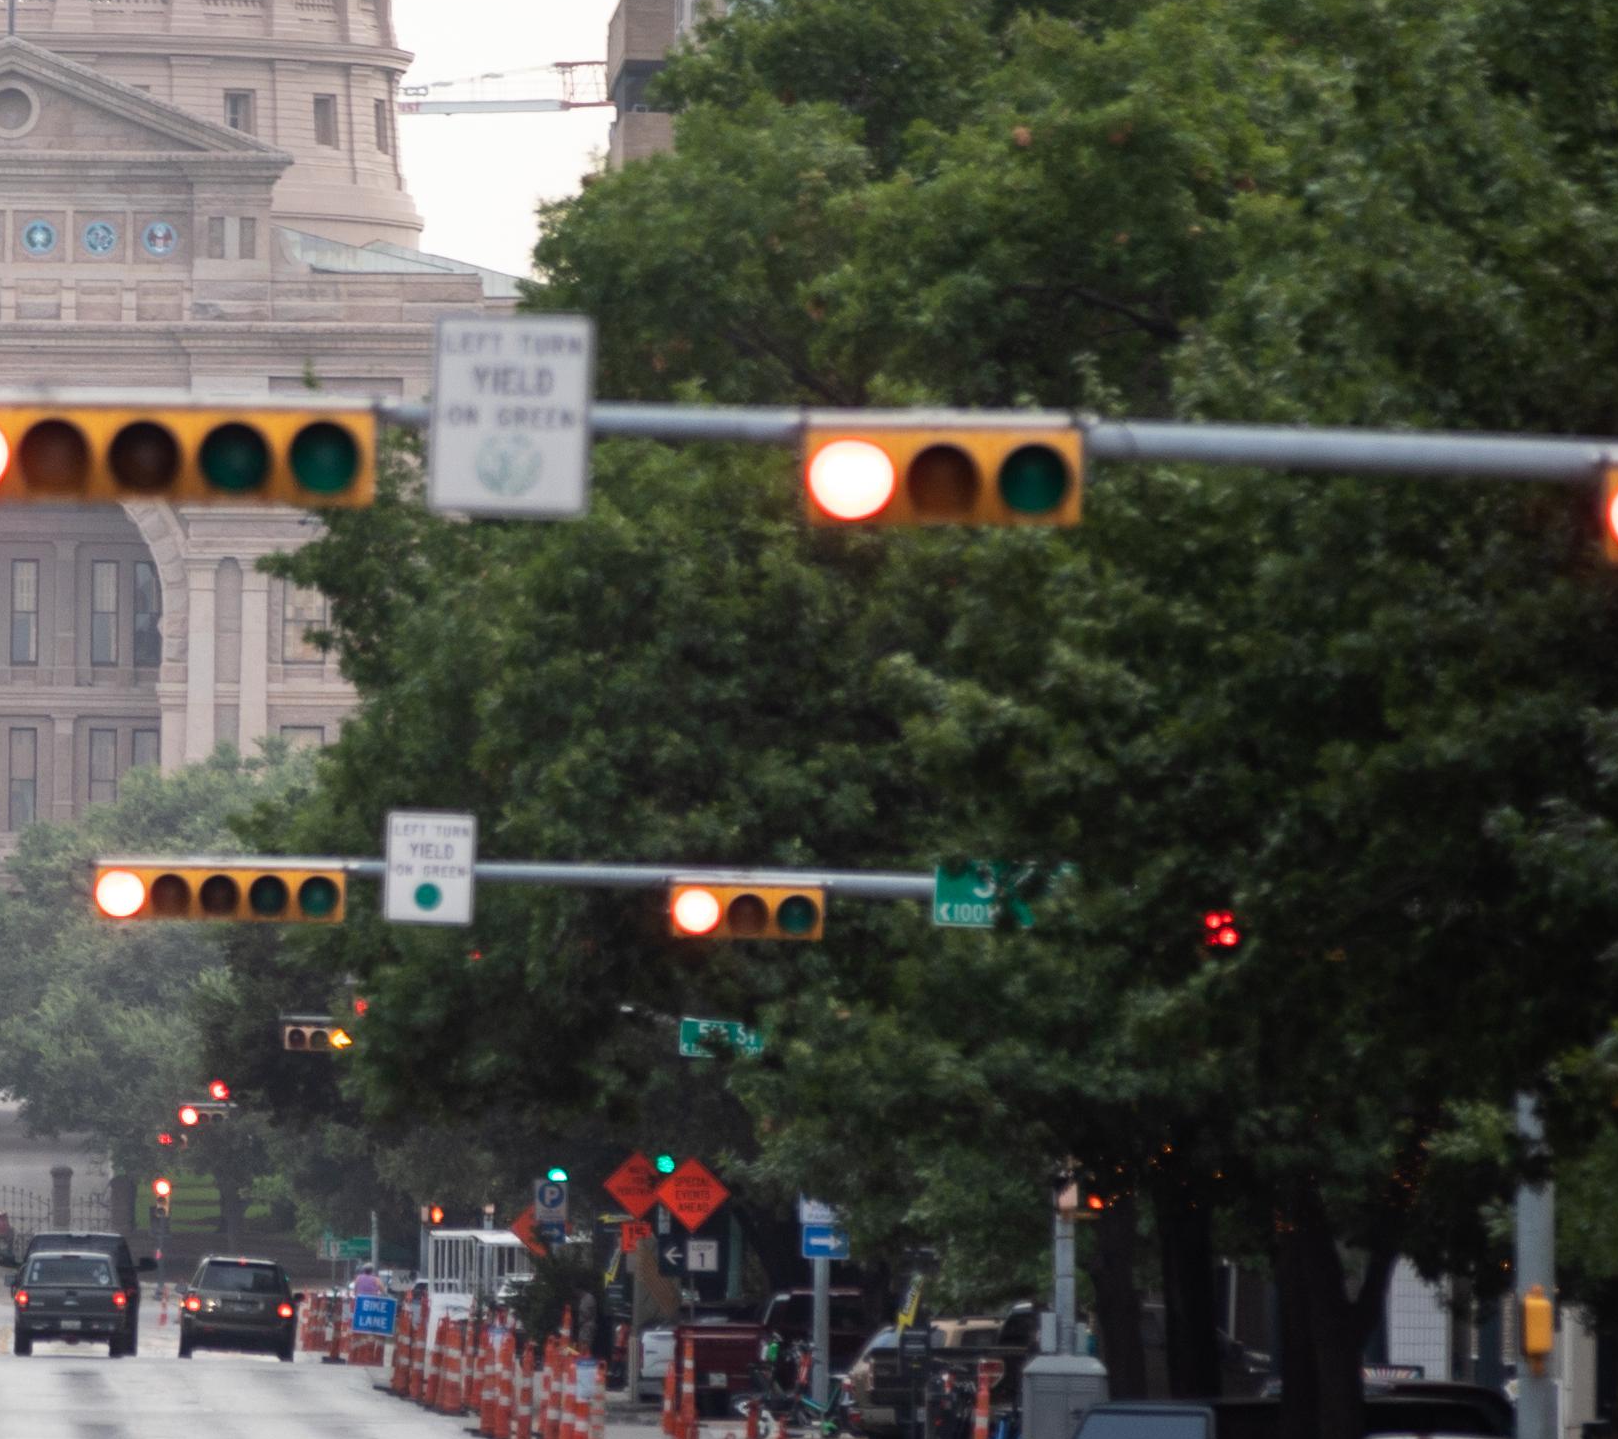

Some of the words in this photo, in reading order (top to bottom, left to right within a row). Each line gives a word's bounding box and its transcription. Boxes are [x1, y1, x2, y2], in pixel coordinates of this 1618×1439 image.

[445, 331, 503, 355] LEFT
[521, 333, 582, 355] TURN
[473, 365, 555, 397] YIELD
[446, 404, 478, 427] ON
[496, 407, 577, 431] GREEN
[395, 824, 427, 836] LEFT
[436, 826, 470, 838] TURN
[410, 843, 454, 860] YIELD
[395, 864, 414, 876] ON
[423, 865, 467, 879] GREEN
[675, 1189, 711, 1200] EVENTS
[362, 1300, 389, 1314] BIKE
[358, 1315, 389, 1331] LANE
